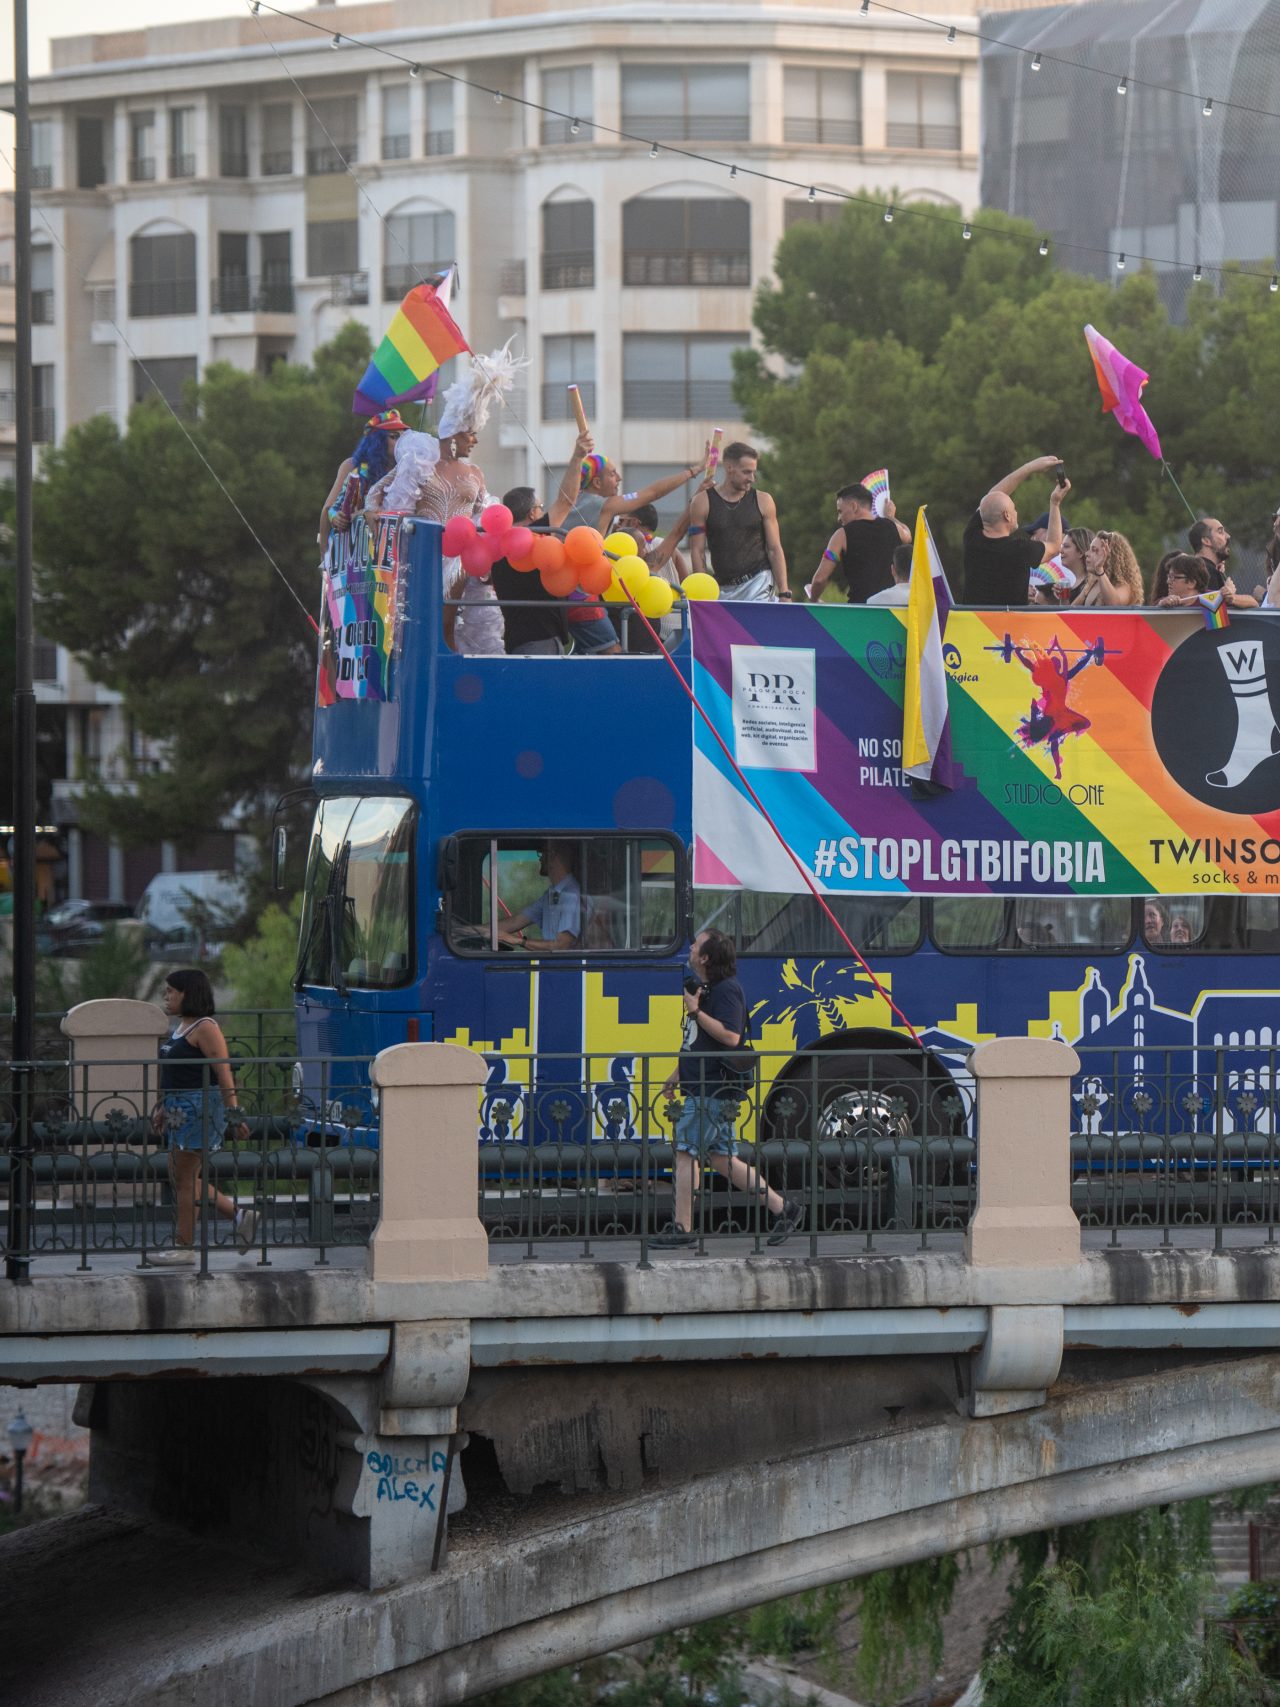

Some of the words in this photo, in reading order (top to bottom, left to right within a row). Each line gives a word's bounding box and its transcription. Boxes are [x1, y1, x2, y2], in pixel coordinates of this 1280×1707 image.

[858, 738, 879, 757] NO
[883, 738, 902, 758] SO
[860, 766, 912, 787] PILATE
[1004, 783, 1063, 805] STUDIO
[1068, 784, 1105, 805] ONE
[813, 836, 1106, 883] #STOPLGTBIFOBIA
[1192, 871, 1240, 884] socks
[1246, 872, 1258, 884] &
[377, 1476, 436, 1511] ALEX
